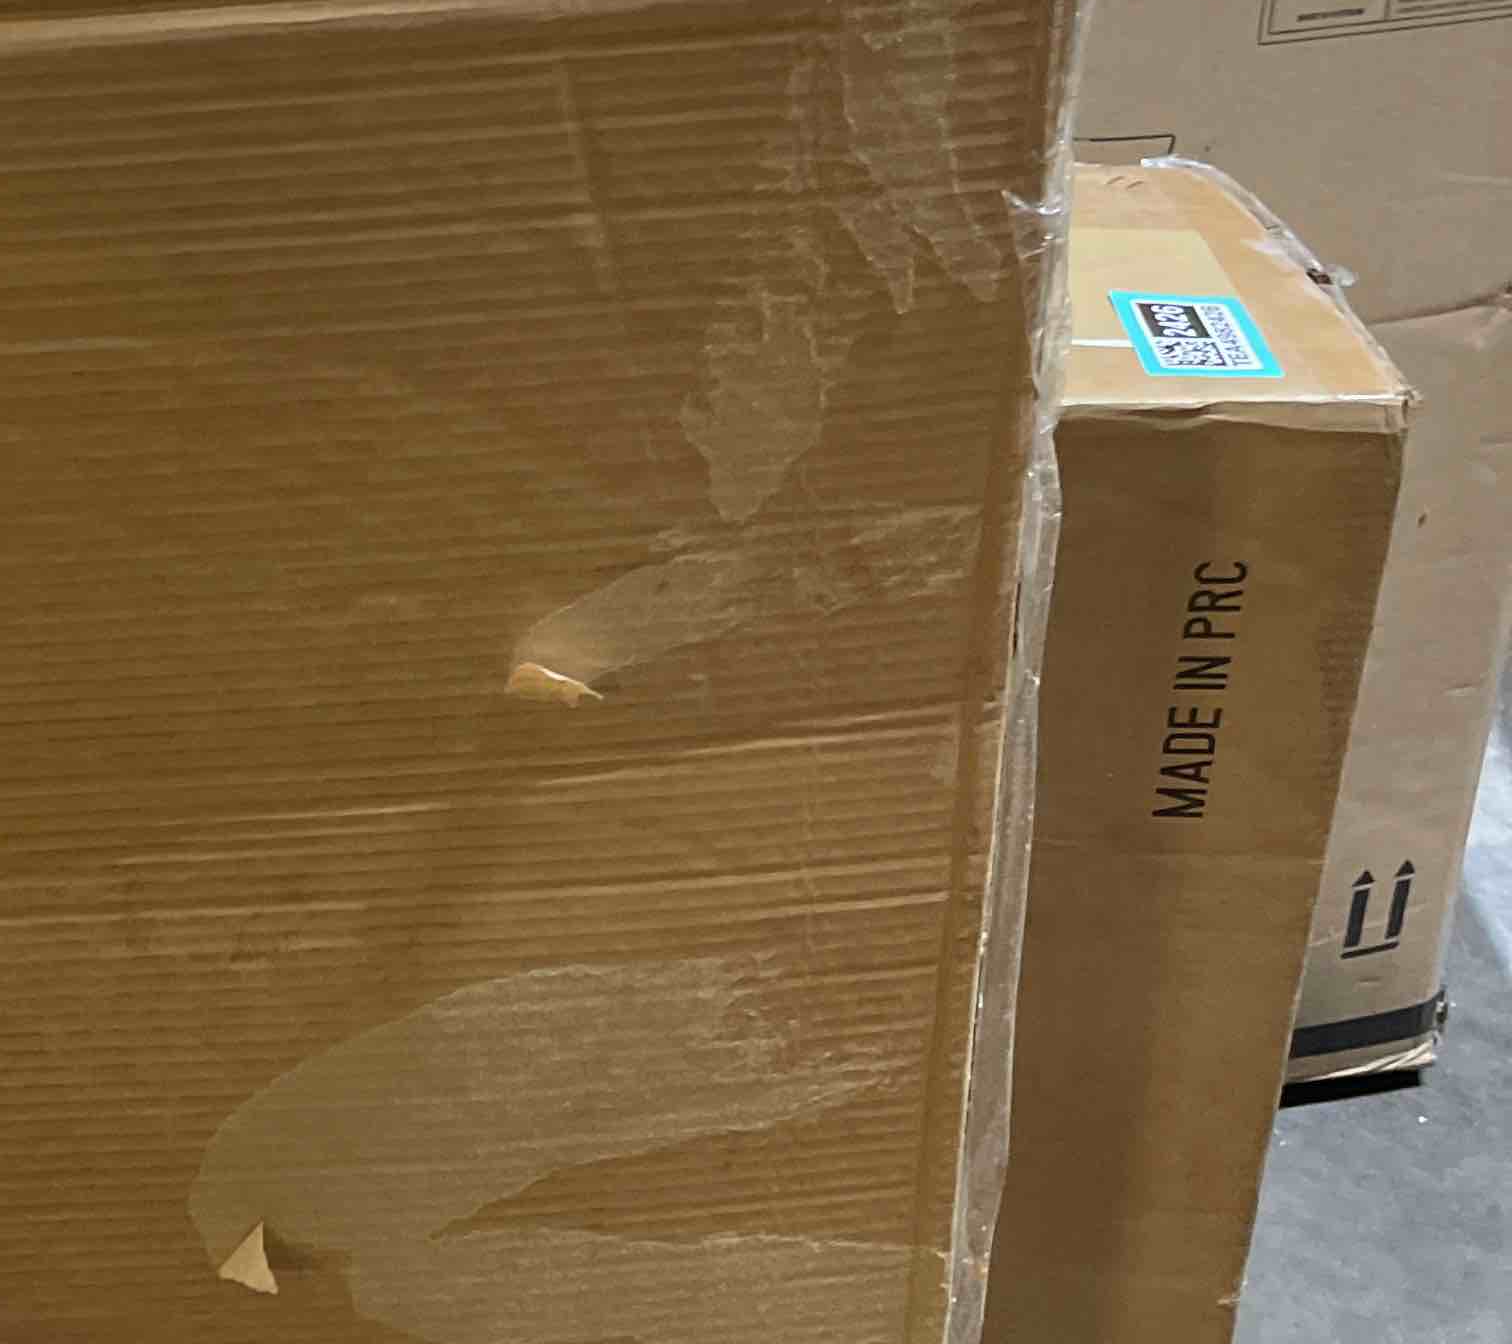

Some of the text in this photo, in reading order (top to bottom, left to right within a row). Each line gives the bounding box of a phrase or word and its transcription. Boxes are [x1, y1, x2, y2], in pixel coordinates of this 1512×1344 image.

[1149, 304, 1199, 338] 2426
[1151, 559, 1248, 818] MADE IN PRC
